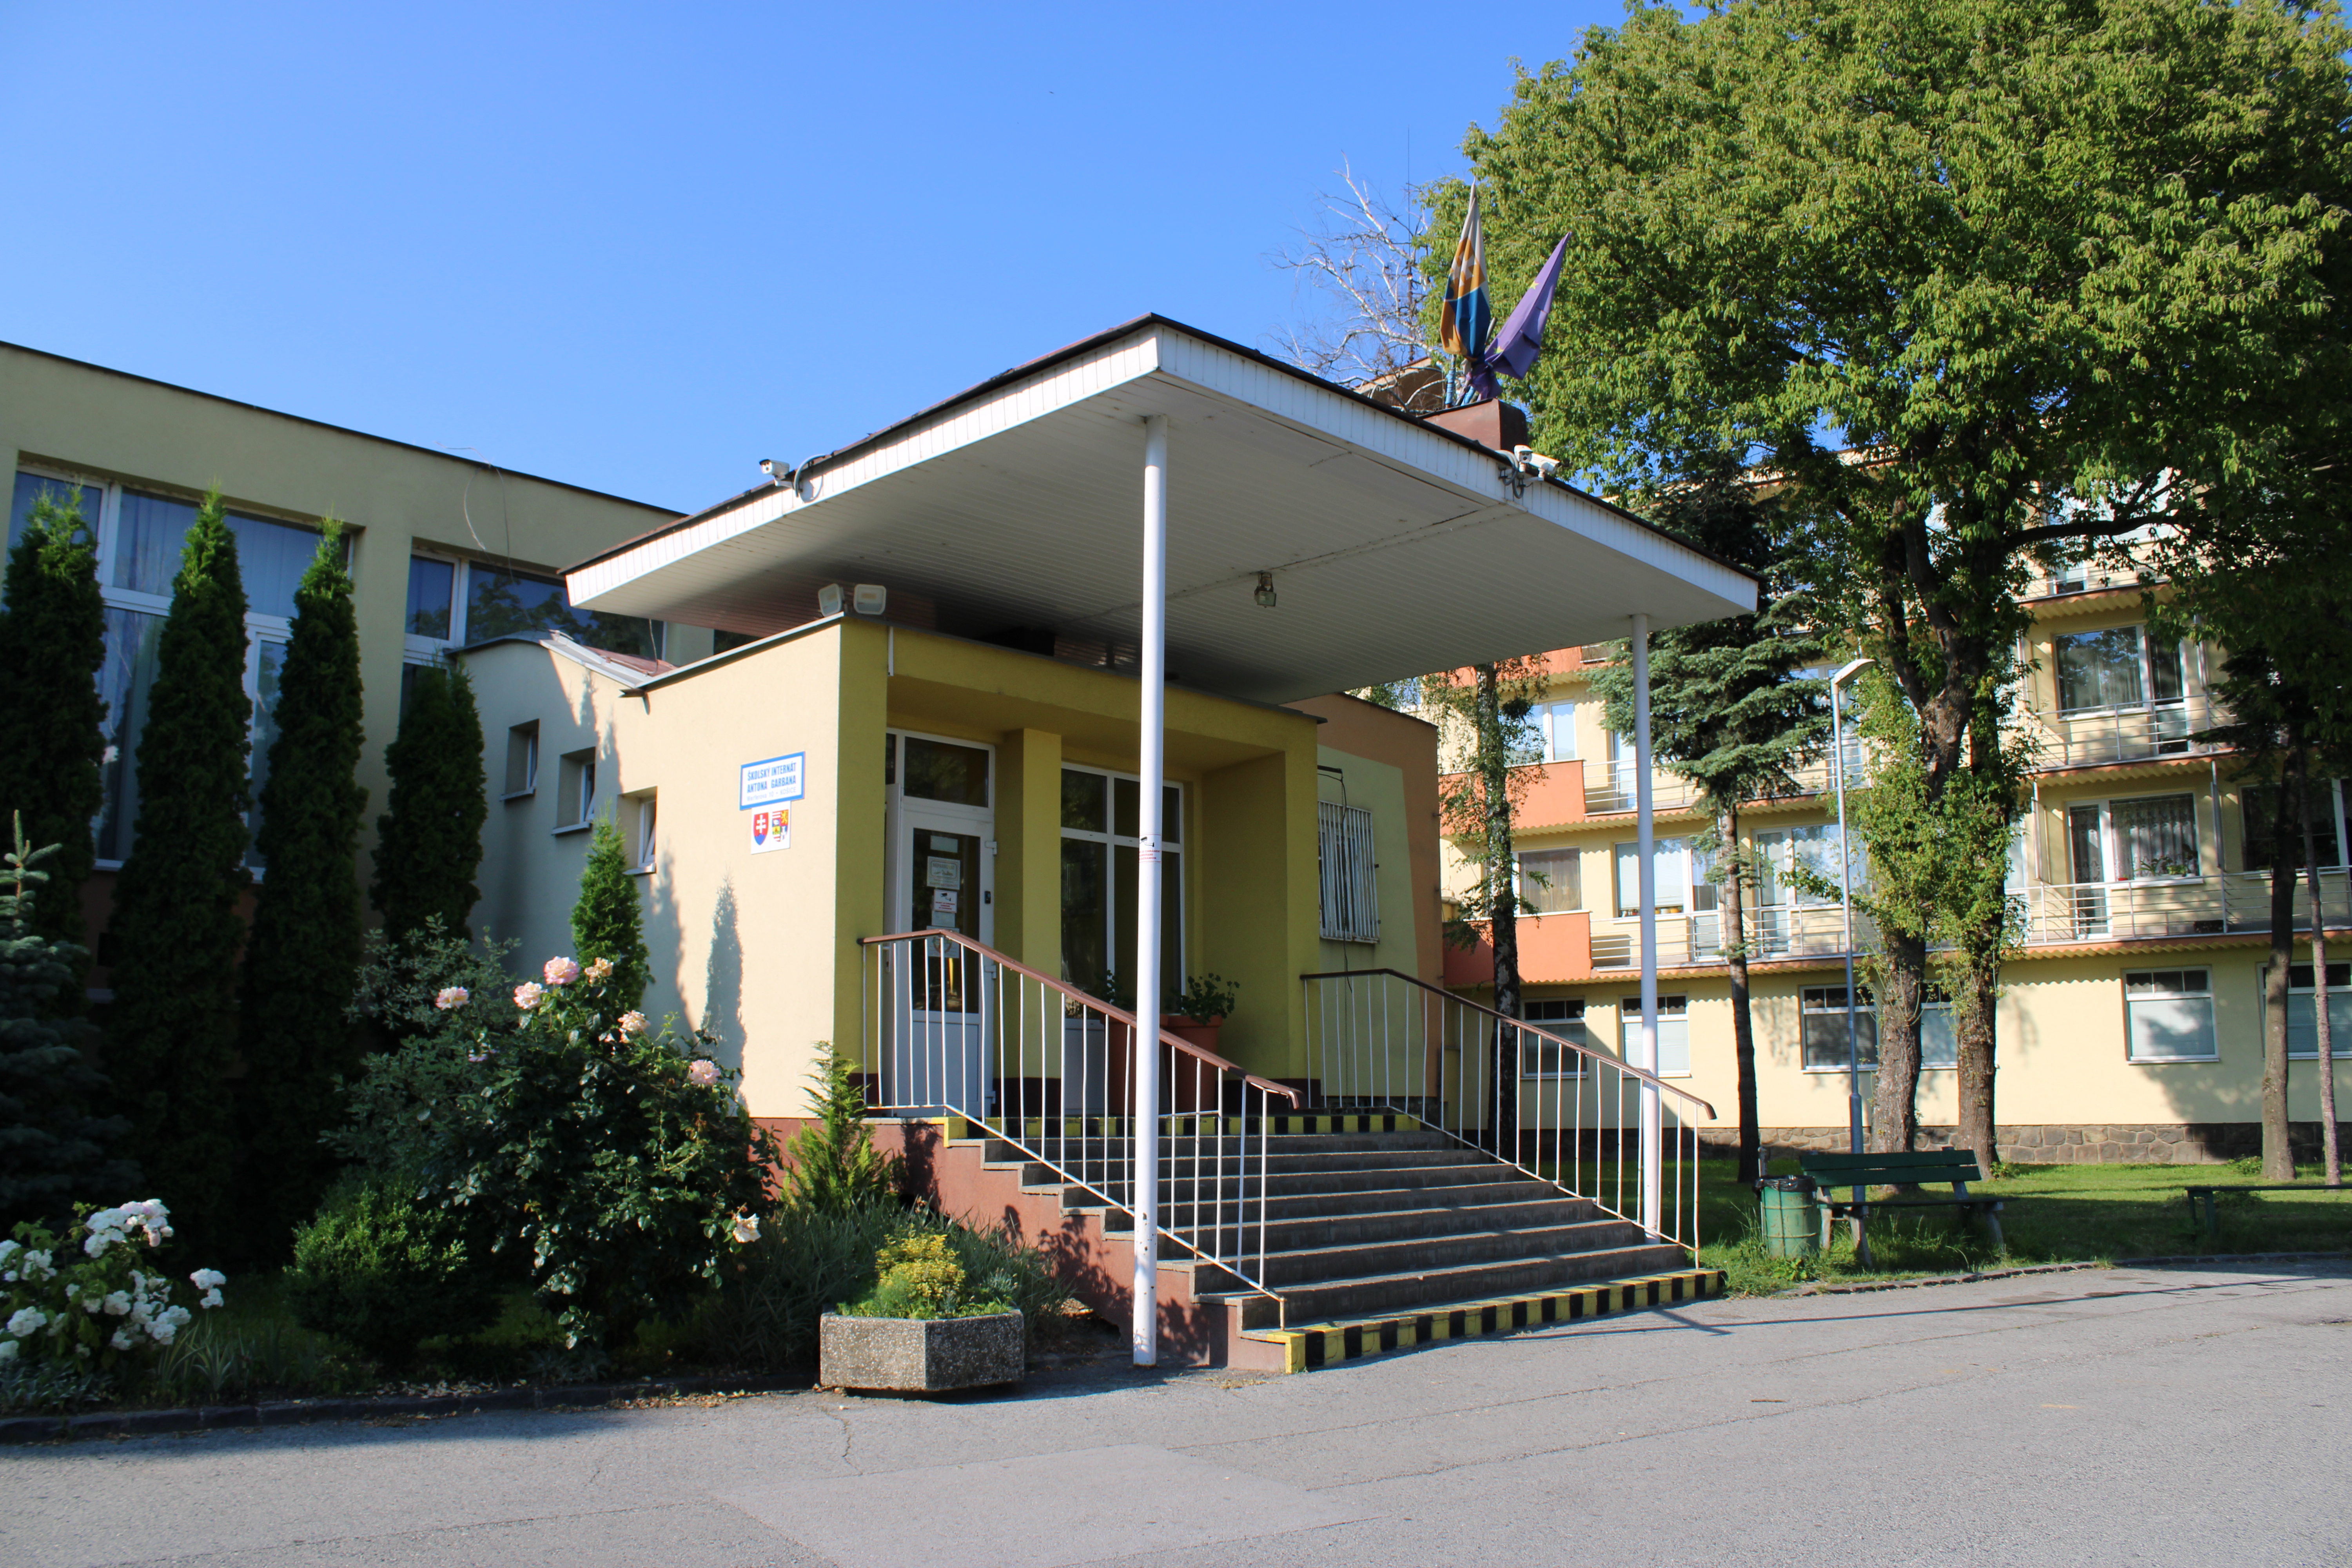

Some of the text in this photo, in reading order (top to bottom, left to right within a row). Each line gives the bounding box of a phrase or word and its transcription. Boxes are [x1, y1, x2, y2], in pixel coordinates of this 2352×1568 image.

[748, 761, 796, 781] ŠKOLSKÝ INTERNÁT
[747, 775, 796, 793] ANTONA GARBANA
